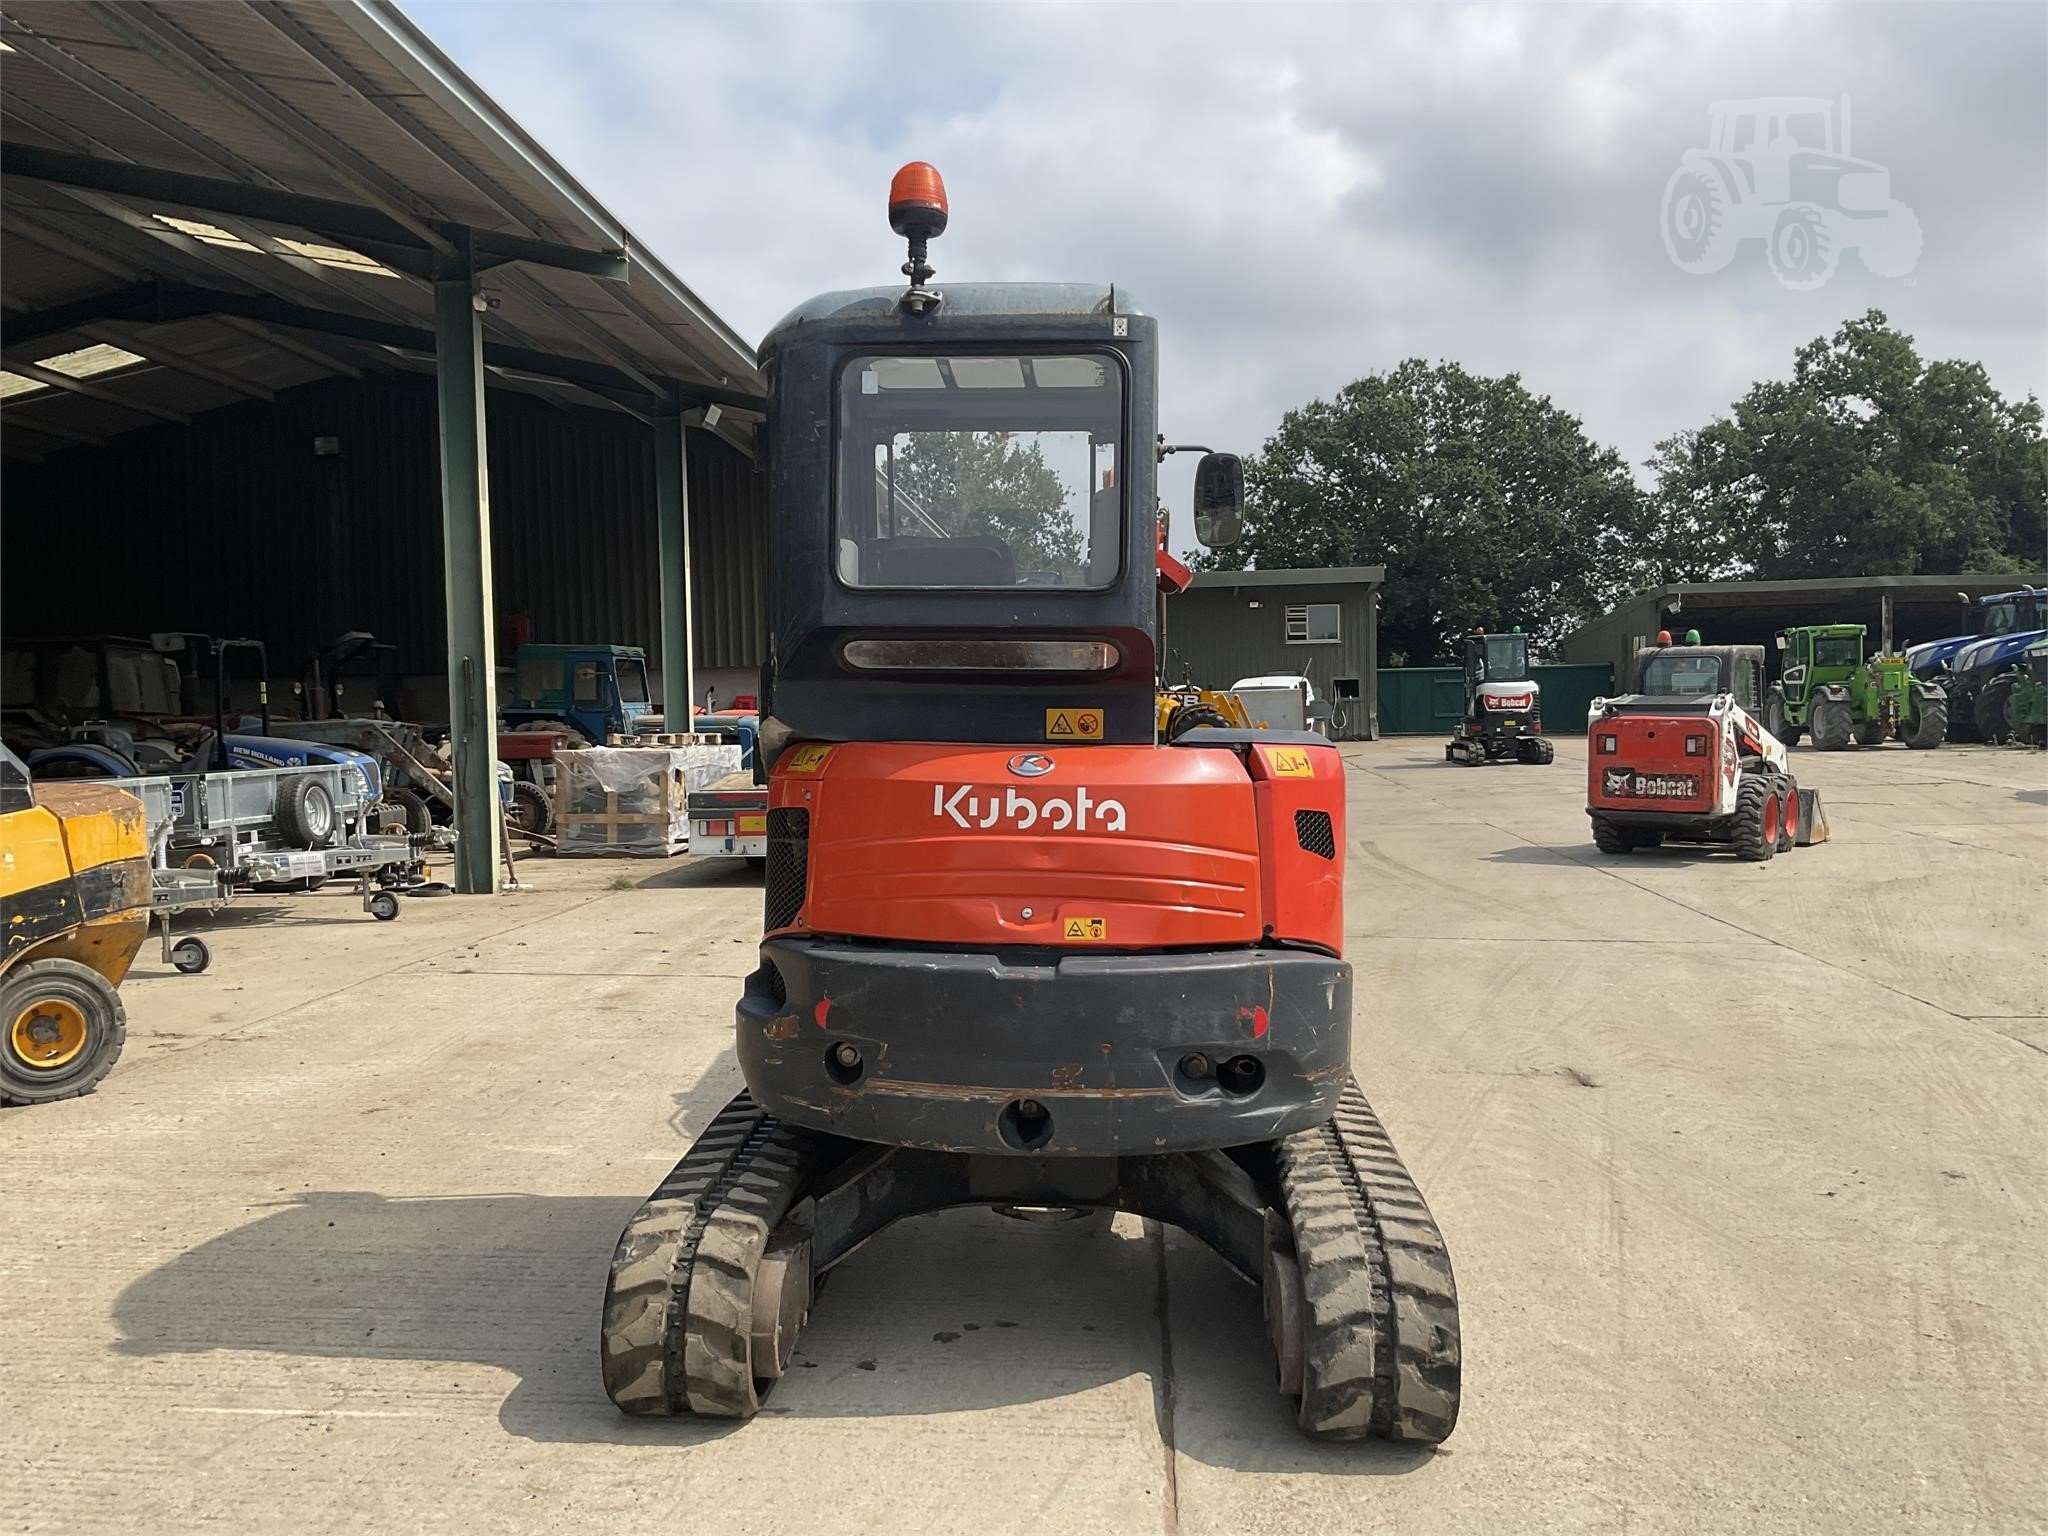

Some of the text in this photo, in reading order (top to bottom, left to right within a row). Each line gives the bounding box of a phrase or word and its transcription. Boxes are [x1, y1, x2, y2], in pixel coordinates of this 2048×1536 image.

[1501, 698, 1526, 708] Bobcat
[233, 746, 285, 767] NEW HOLLAND
[1635, 777, 1693, 796] Bobcat
[933, 785, 1126, 831] Kubota
